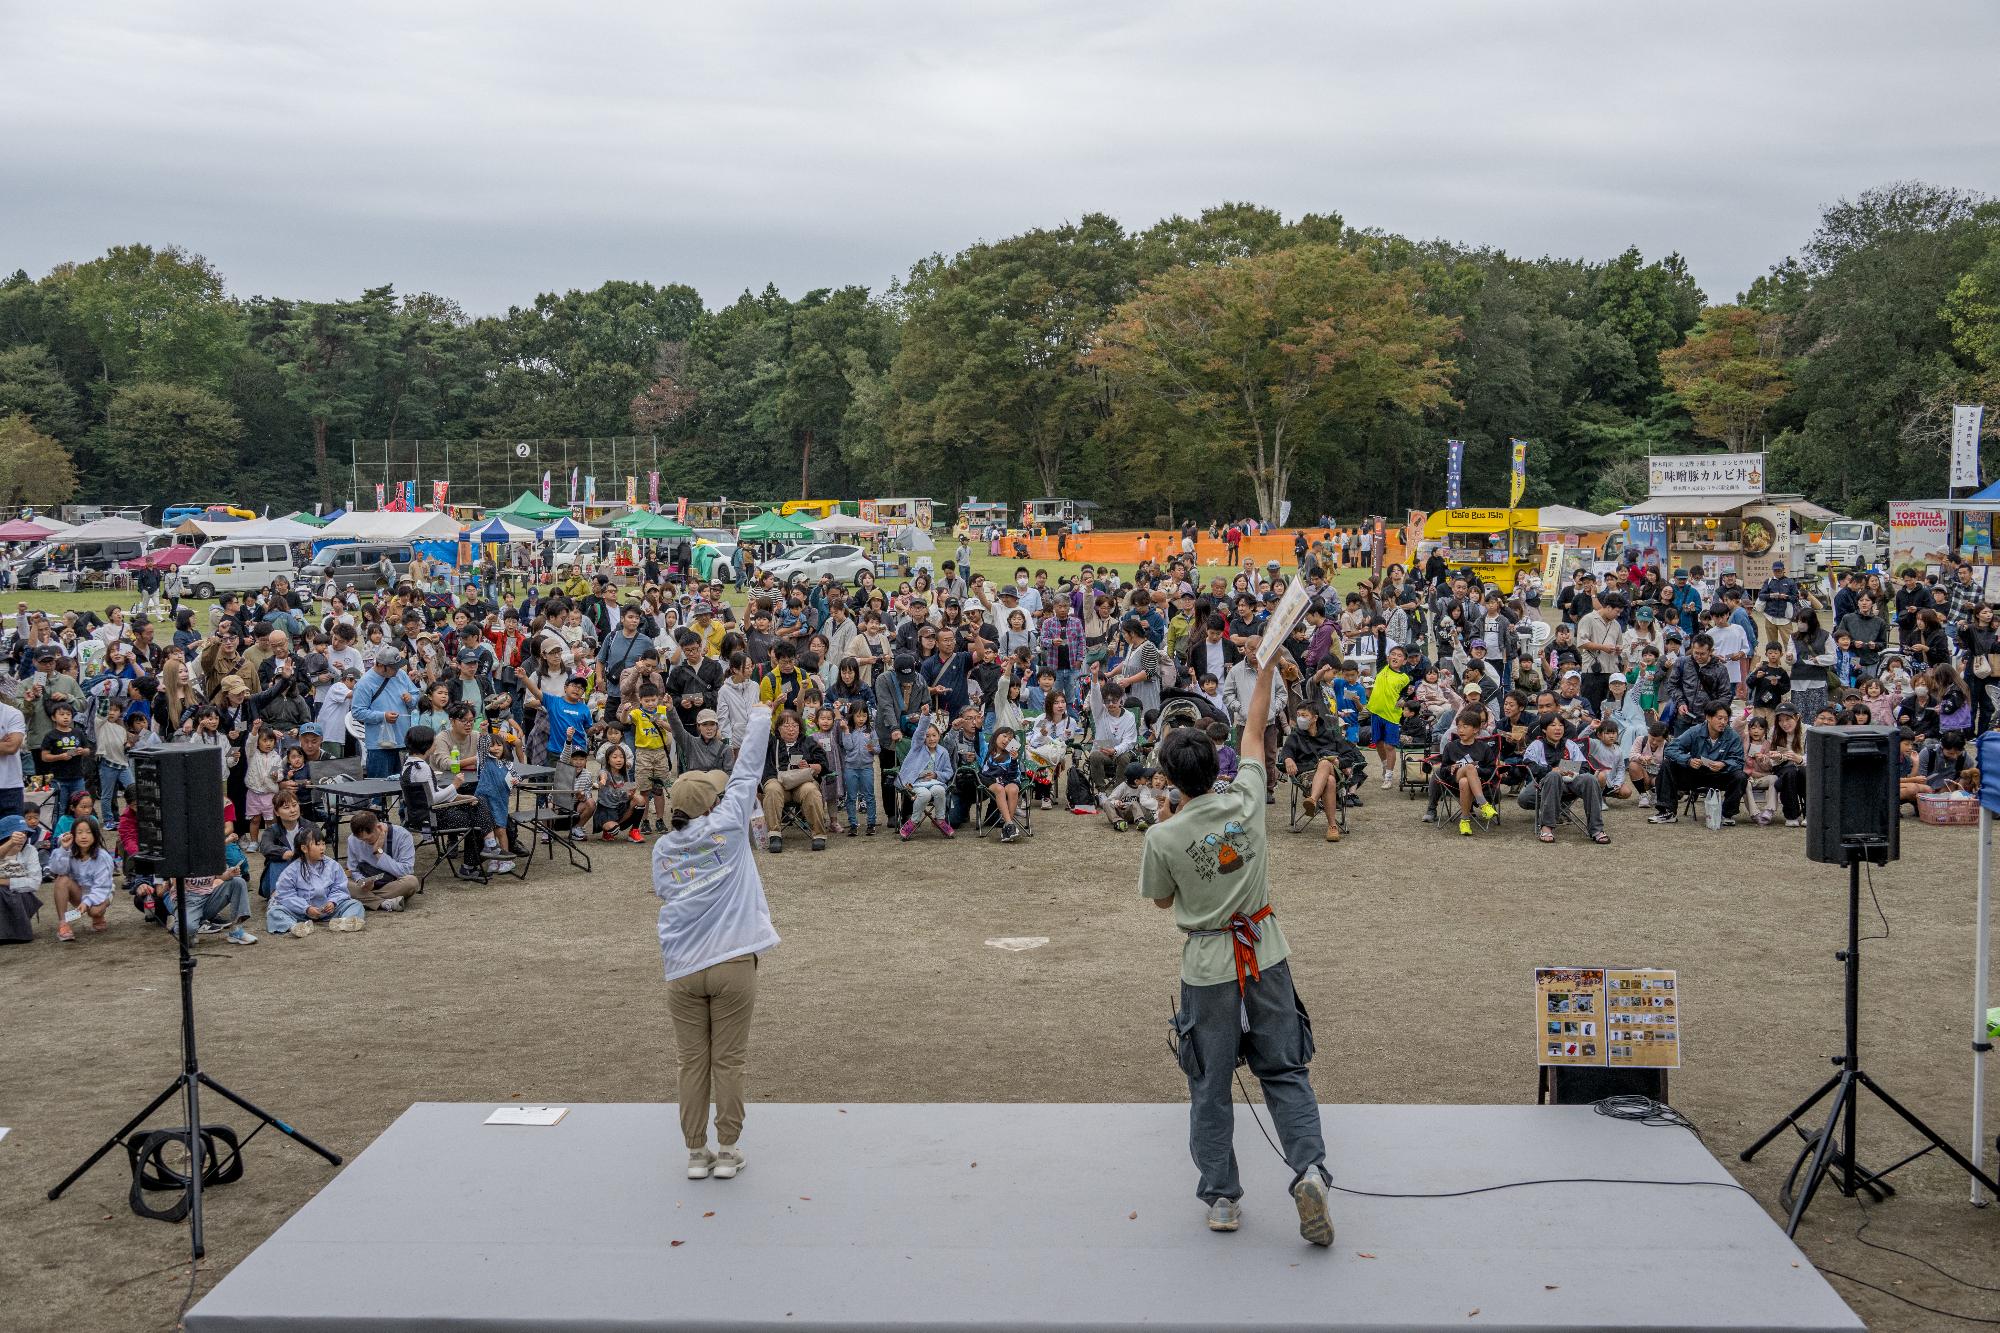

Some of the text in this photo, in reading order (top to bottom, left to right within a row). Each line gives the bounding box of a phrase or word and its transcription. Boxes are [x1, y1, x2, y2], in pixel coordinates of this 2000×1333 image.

[520, 445, 527, 457] 2
[1664, 468, 1747, 483] 味噌豚カルビ丼
[1452, 511, 1469, 519] Cafe
[1471, 511, 1486, 520] Bus
[1895, 512, 1942, 520] TORTILLA
[1637, 521, 1665, 533] TAILS
[1890, 519, 1947, 527] SANDWICH
